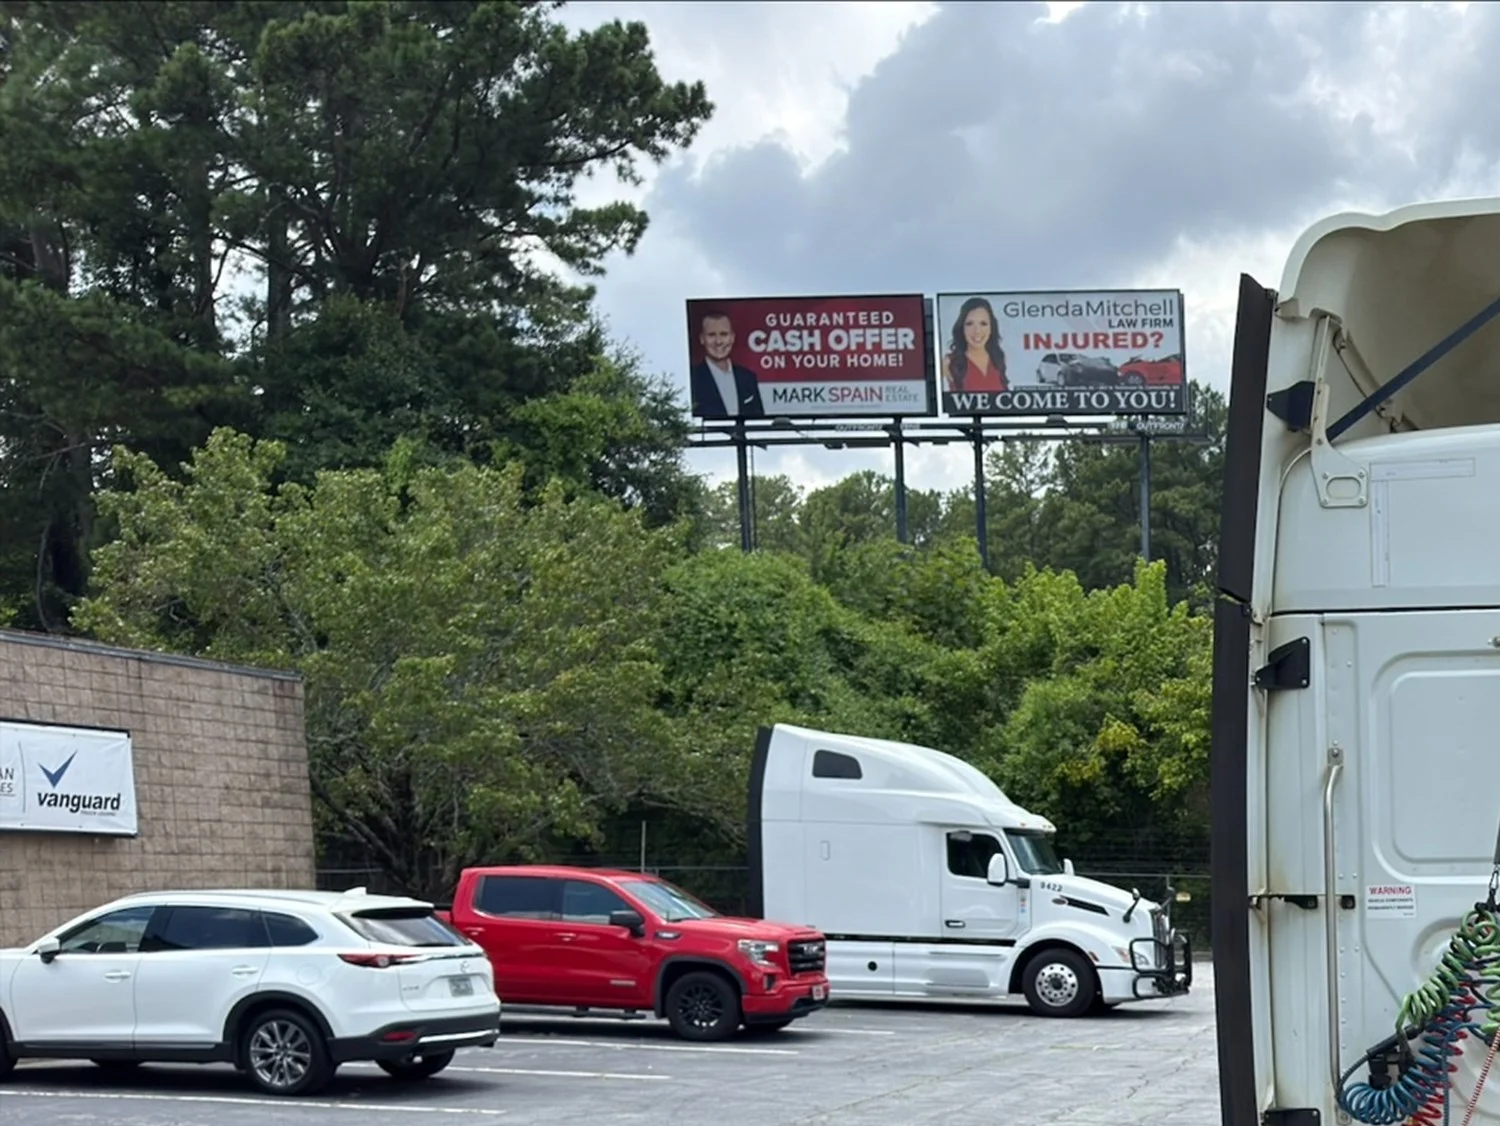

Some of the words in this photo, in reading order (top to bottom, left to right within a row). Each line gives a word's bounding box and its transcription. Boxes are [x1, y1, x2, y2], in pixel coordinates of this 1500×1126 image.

[765, 311, 895, 327] GUARANTEED
[1108, 319, 1138, 329] LAW
[1141, 318, 1174, 328] FIRM
[748, 330, 821, 353] CASH
[828, 327, 915, 351] OFFER
[1023, 331, 1165, 350] INJURED?
[760, 355, 786, 369] ON
[792, 354, 841, 368] YOUR
[847, 352, 903, 367] HOME!
[773, 386, 826, 404] MARK
[828, 386, 884, 403] SPAIN
[951, 393, 991, 410] WE
[995, 392, 1069, 410] COME
[1074, 392, 1110, 409] TO
[1113, 391, 1177, 409] YOU!
[37, 792, 121, 814] vanguard
[1369, 886, 1412, 896] WARNING
